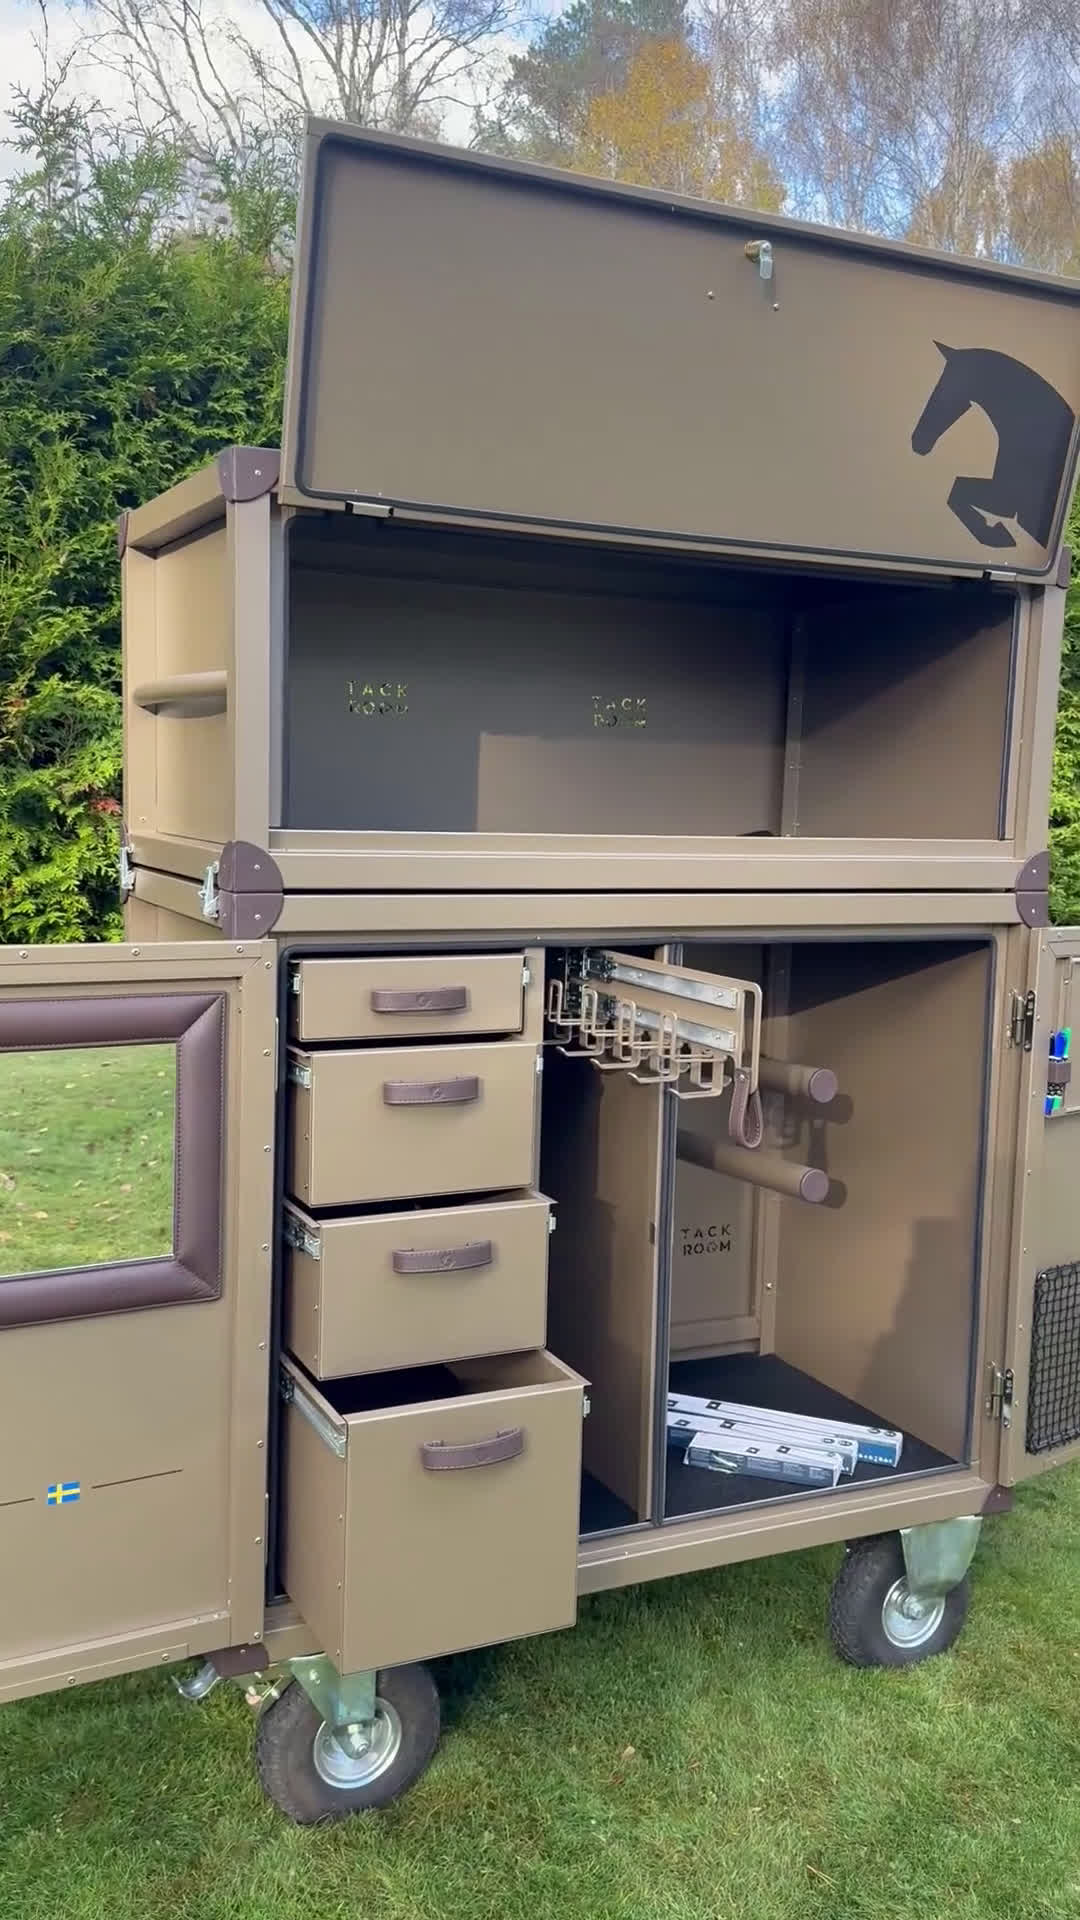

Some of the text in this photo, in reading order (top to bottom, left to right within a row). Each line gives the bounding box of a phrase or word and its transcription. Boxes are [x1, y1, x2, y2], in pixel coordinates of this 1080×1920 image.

[347, 680, 408, 697] TACK
[592, 696, 646, 711] TACK
[593, 713, 646, 729] ROM
[680, 1224, 731, 1239] TACK
[683, 1240, 731, 1256] ROOM
